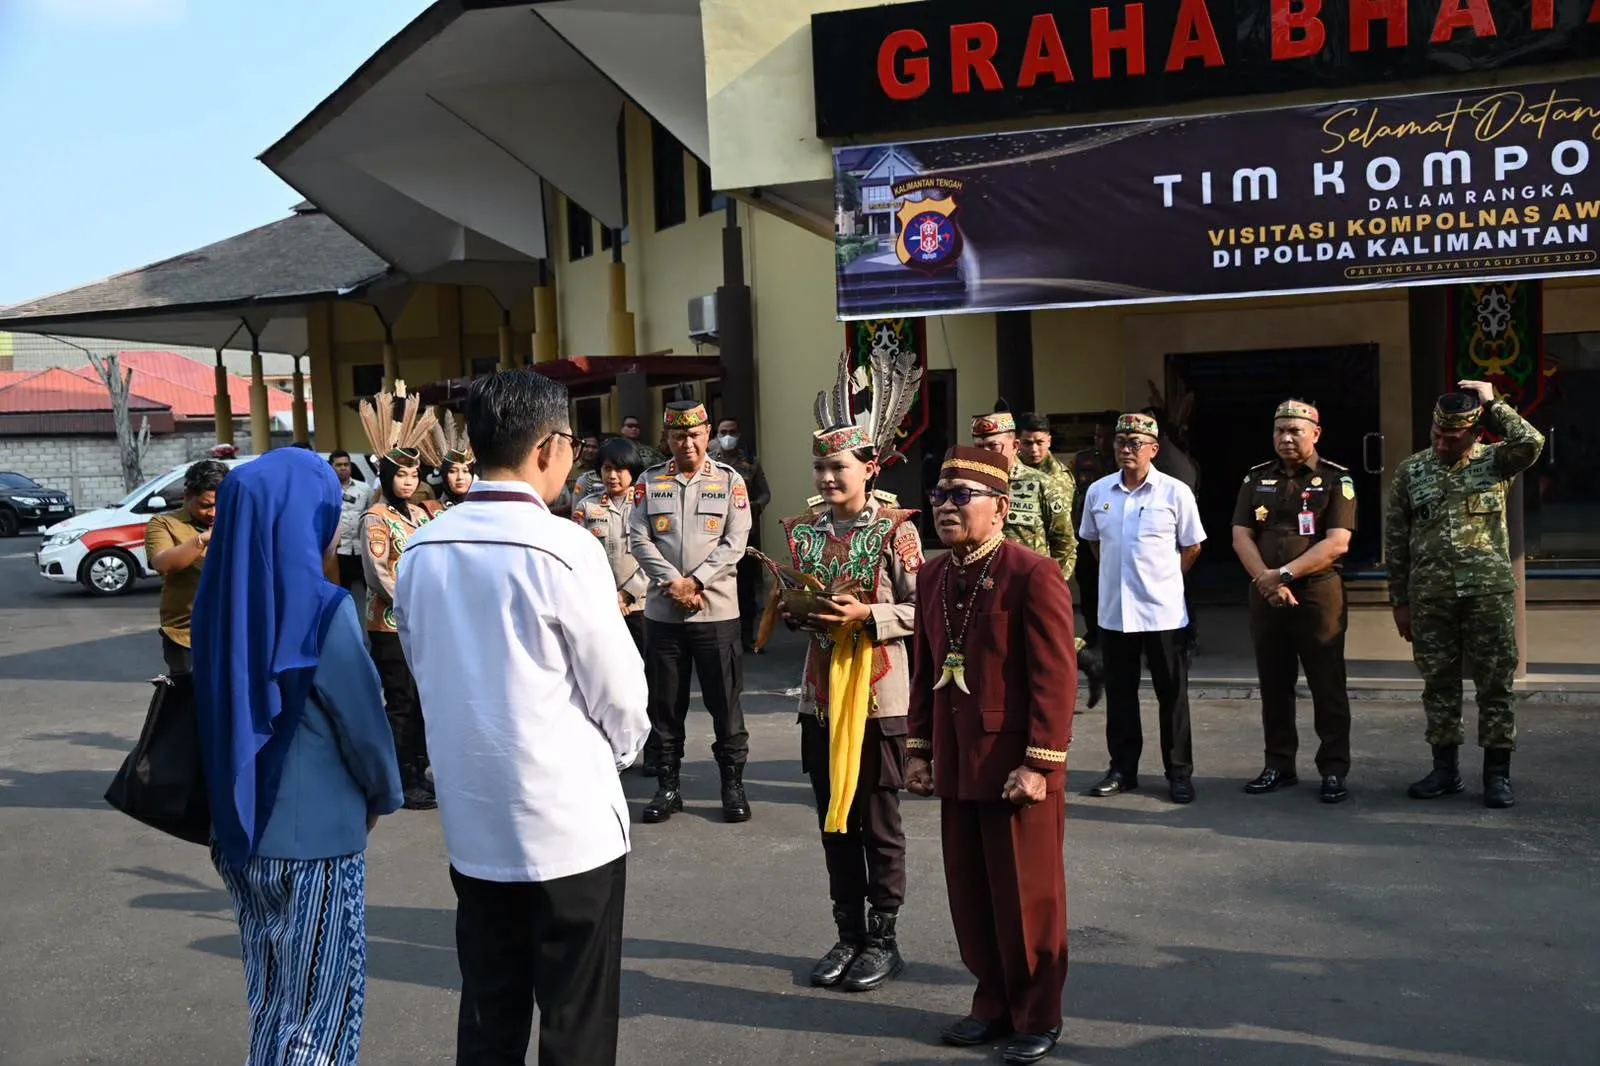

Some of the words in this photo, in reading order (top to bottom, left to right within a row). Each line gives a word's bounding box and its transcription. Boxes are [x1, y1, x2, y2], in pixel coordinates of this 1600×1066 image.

[877, 0, 1225, 101] GRAHA
[1271, 0, 1600, 61] BHA
[1321, 98, 1484, 154] Selamat
[894, 179, 935, 195] KALIMANTAN
[935, 178, 963, 190] TENGAH
[1153, 166, 1278, 208] TIM
[1312, 139, 1590, 196] KOMPO
[1368, 192, 1454, 211] DALAM
[1465, 182, 1574, 204] RANGKA
[1208, 221, 1335, 246] VISITASI
[1347, 205, 1541, 236] KOMPOLNAS
[1213, 249, 1242, 269] DI
[1254, 241, 1355, 265] POLDA
[1367, 223, 1588, 258] KALIMANTAN
[1350, 264, 1422, 275] PALANGKA
[1427, 261, 1459, 271] RAYA
[1465, 261, 1479, 269] 10
[1484, 255, 1549, 267] AGUSTUS
[1555, 253, 1590, 263] 2026
[650, 491, 673, 499] IWAN
